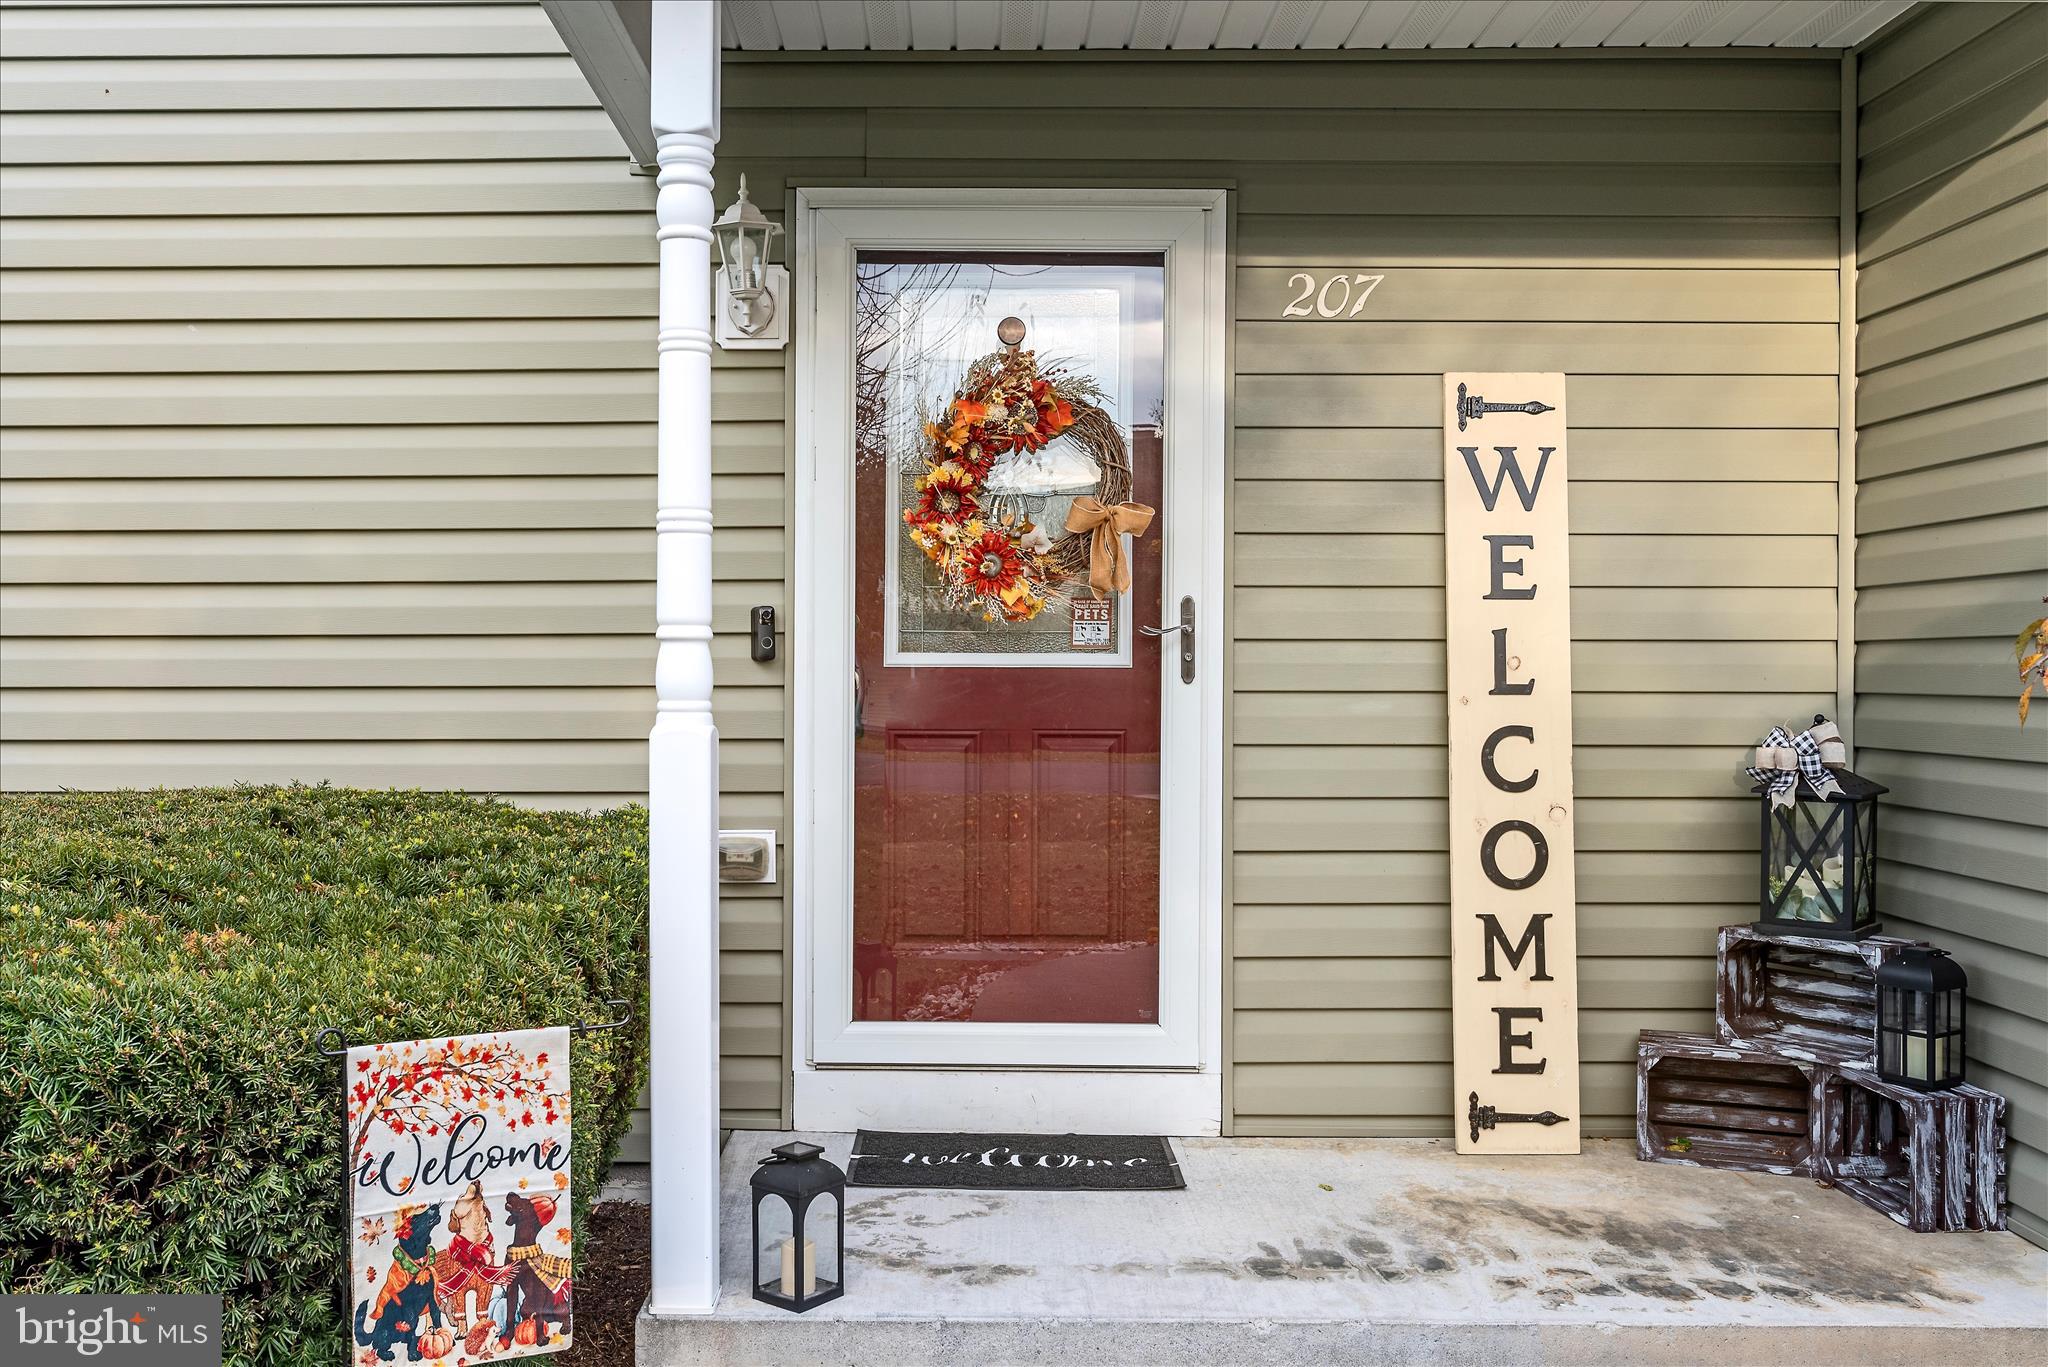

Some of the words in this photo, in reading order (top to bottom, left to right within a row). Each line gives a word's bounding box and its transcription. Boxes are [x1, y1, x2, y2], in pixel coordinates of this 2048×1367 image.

[1282, 273, 1384, 318] 207
[1074, 609, 1109, 620] PETS
[1456, 446, 1557, 1075] WELCOME
[349, 1114, 571, 1197] Welcome
